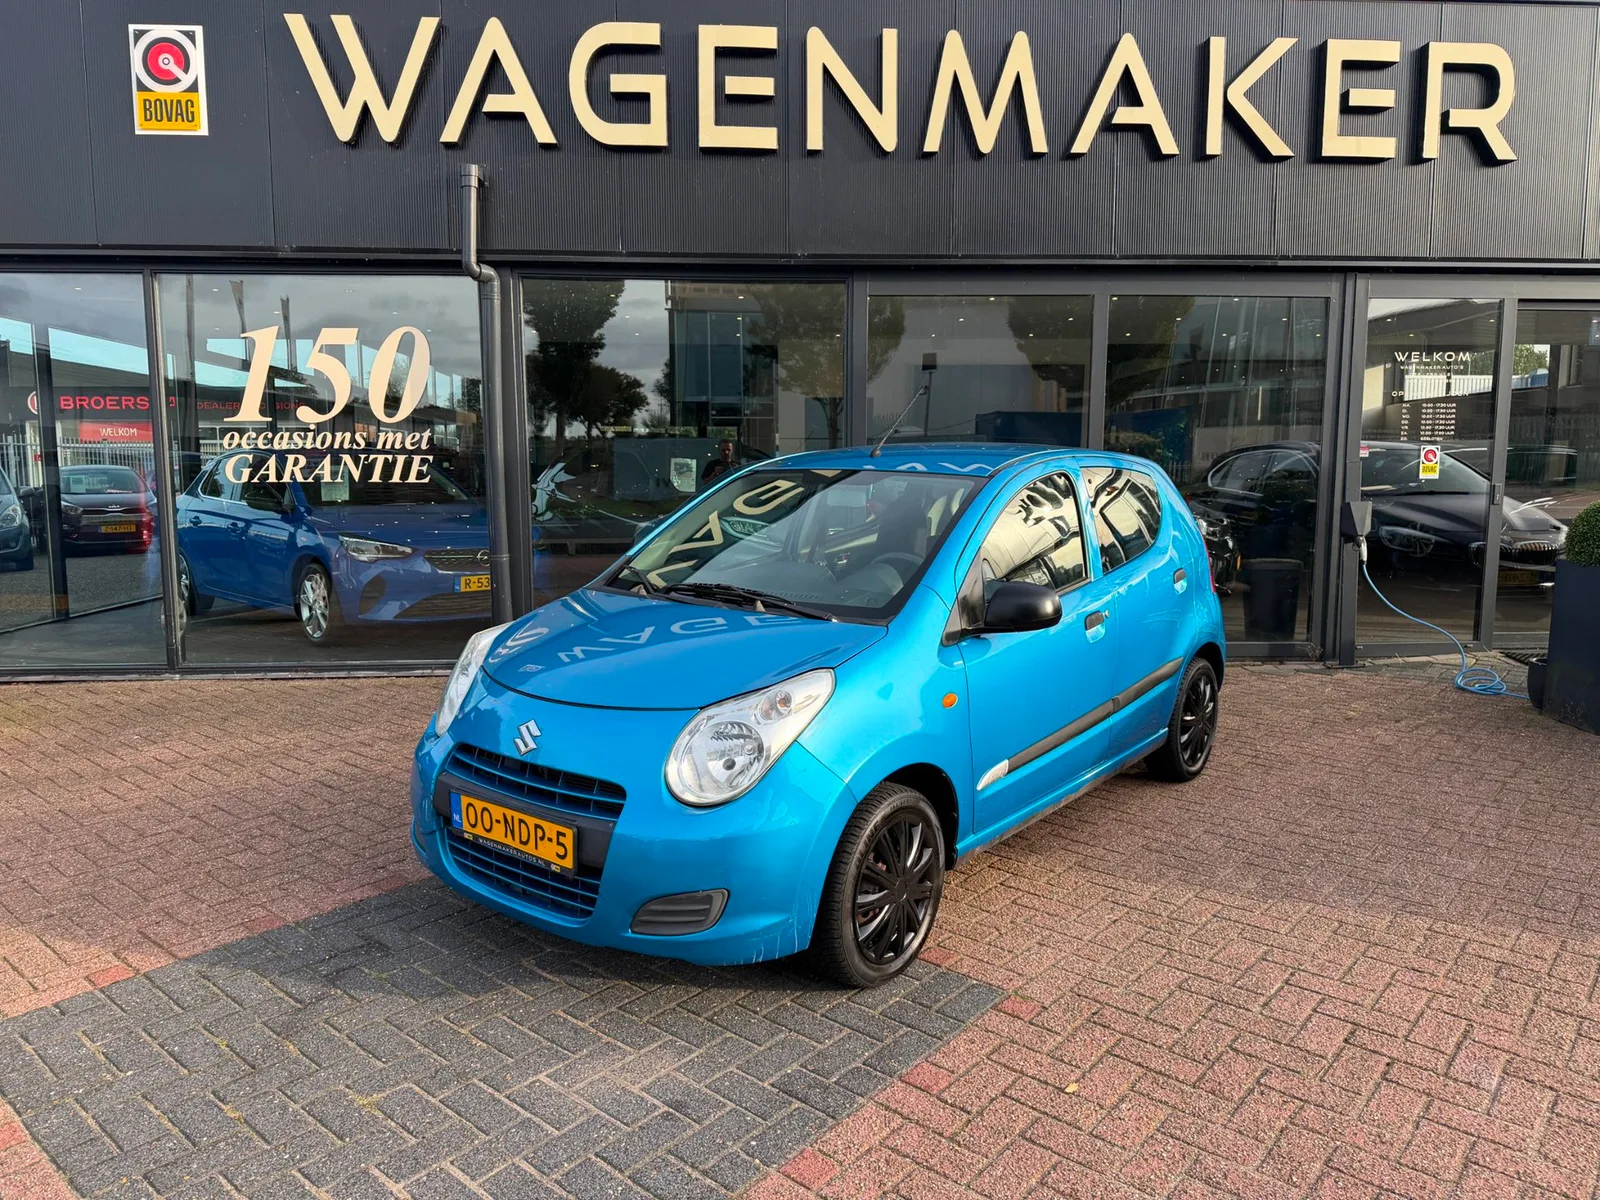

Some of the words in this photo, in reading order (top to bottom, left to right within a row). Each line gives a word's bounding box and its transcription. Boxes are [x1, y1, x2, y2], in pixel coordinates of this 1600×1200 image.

[283, 14, 1517, 162] WAGENMAKER
[142, 98, 195, 123] BOVAG
[1394, 351, 1471, 362] WELKOM
[223, 325, 431, 424] 150
[60, 396, 176, 411] BROERS
[100, 427, 138, 437] WELKOM
[222, 423, 367, 451] occasions
[376, 427, 433, 451] met
[225, 453, 434, 484] GARANTIE
[464, 577, 490, 589] R-53
[453, 812, 462, 823] NL
[465, 801, 568, 861] 00-NDP-5
